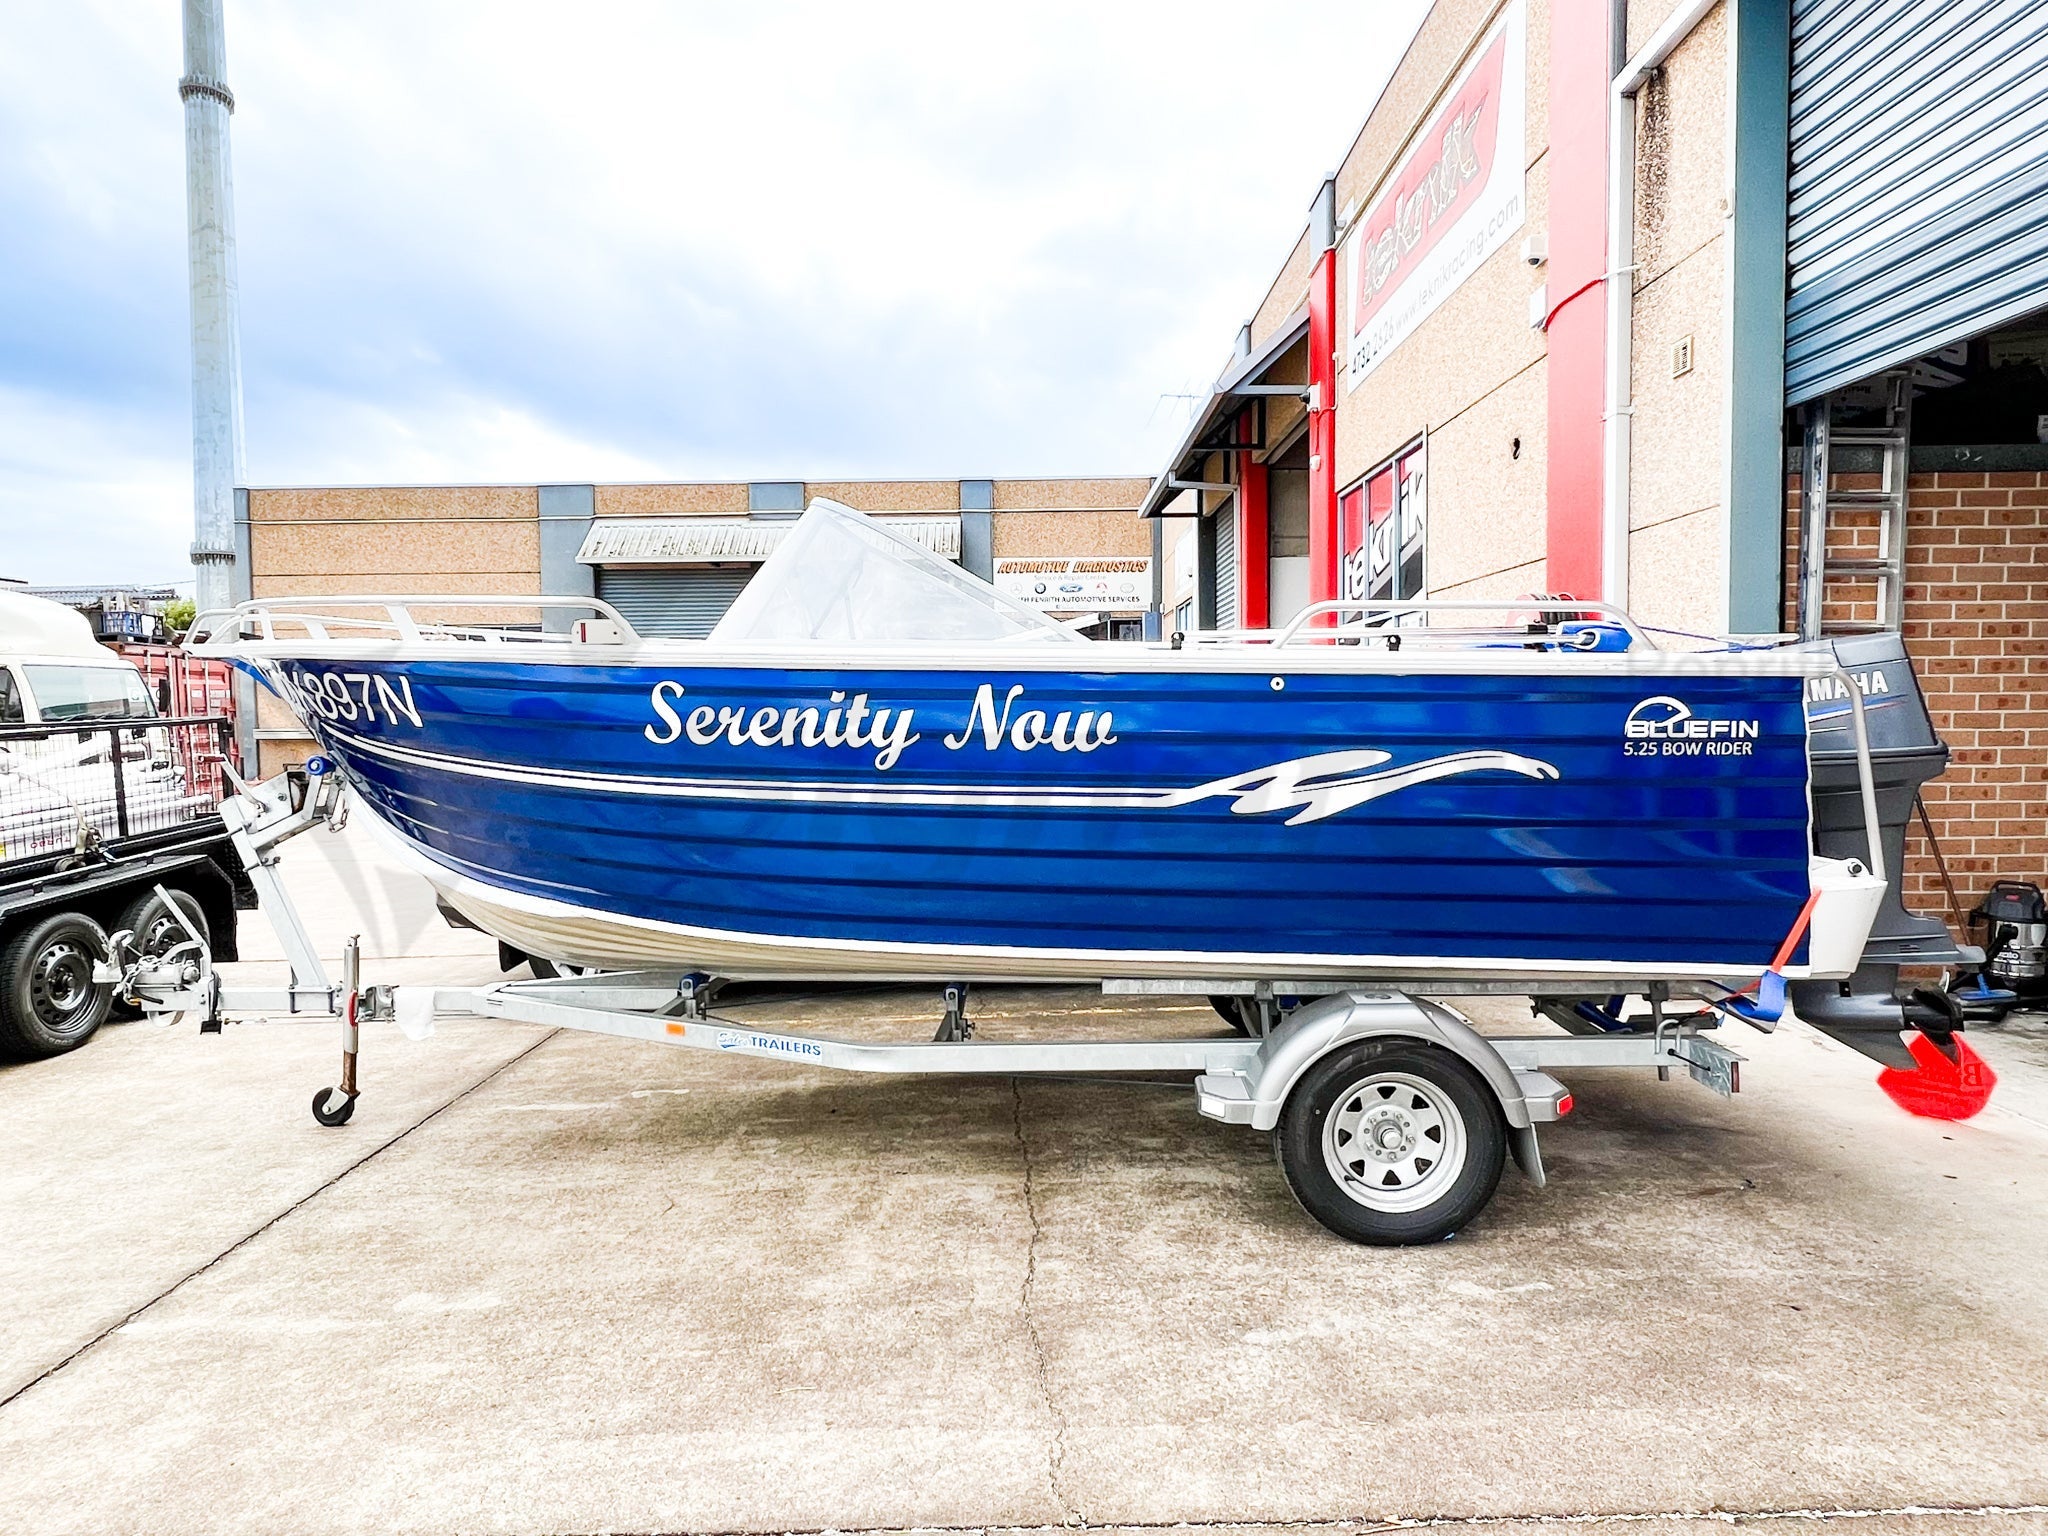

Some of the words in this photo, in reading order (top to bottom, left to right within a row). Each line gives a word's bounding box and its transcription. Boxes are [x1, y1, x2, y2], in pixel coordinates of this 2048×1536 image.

[1352, 341, 1370, 376] 4732
[998, 561, 1071, 574] AUTOMOTIVE
[1073, 560, 1148, 573] DIAGNOSTICS
[1803, 671, 1889, 702] MAHA
[644, 680, 919, 771] Serenity
[944, 683, 1118, 752] Now
[1625, 720, 1759, 738] BLUEFIN
[1623, 742, 1658, 756] 5.25
[1662, 741, 1703, 756] BOW
[1706, 741, 1753, 756] RIDER
[750, 1036, 822, 1056] TRAILERS
